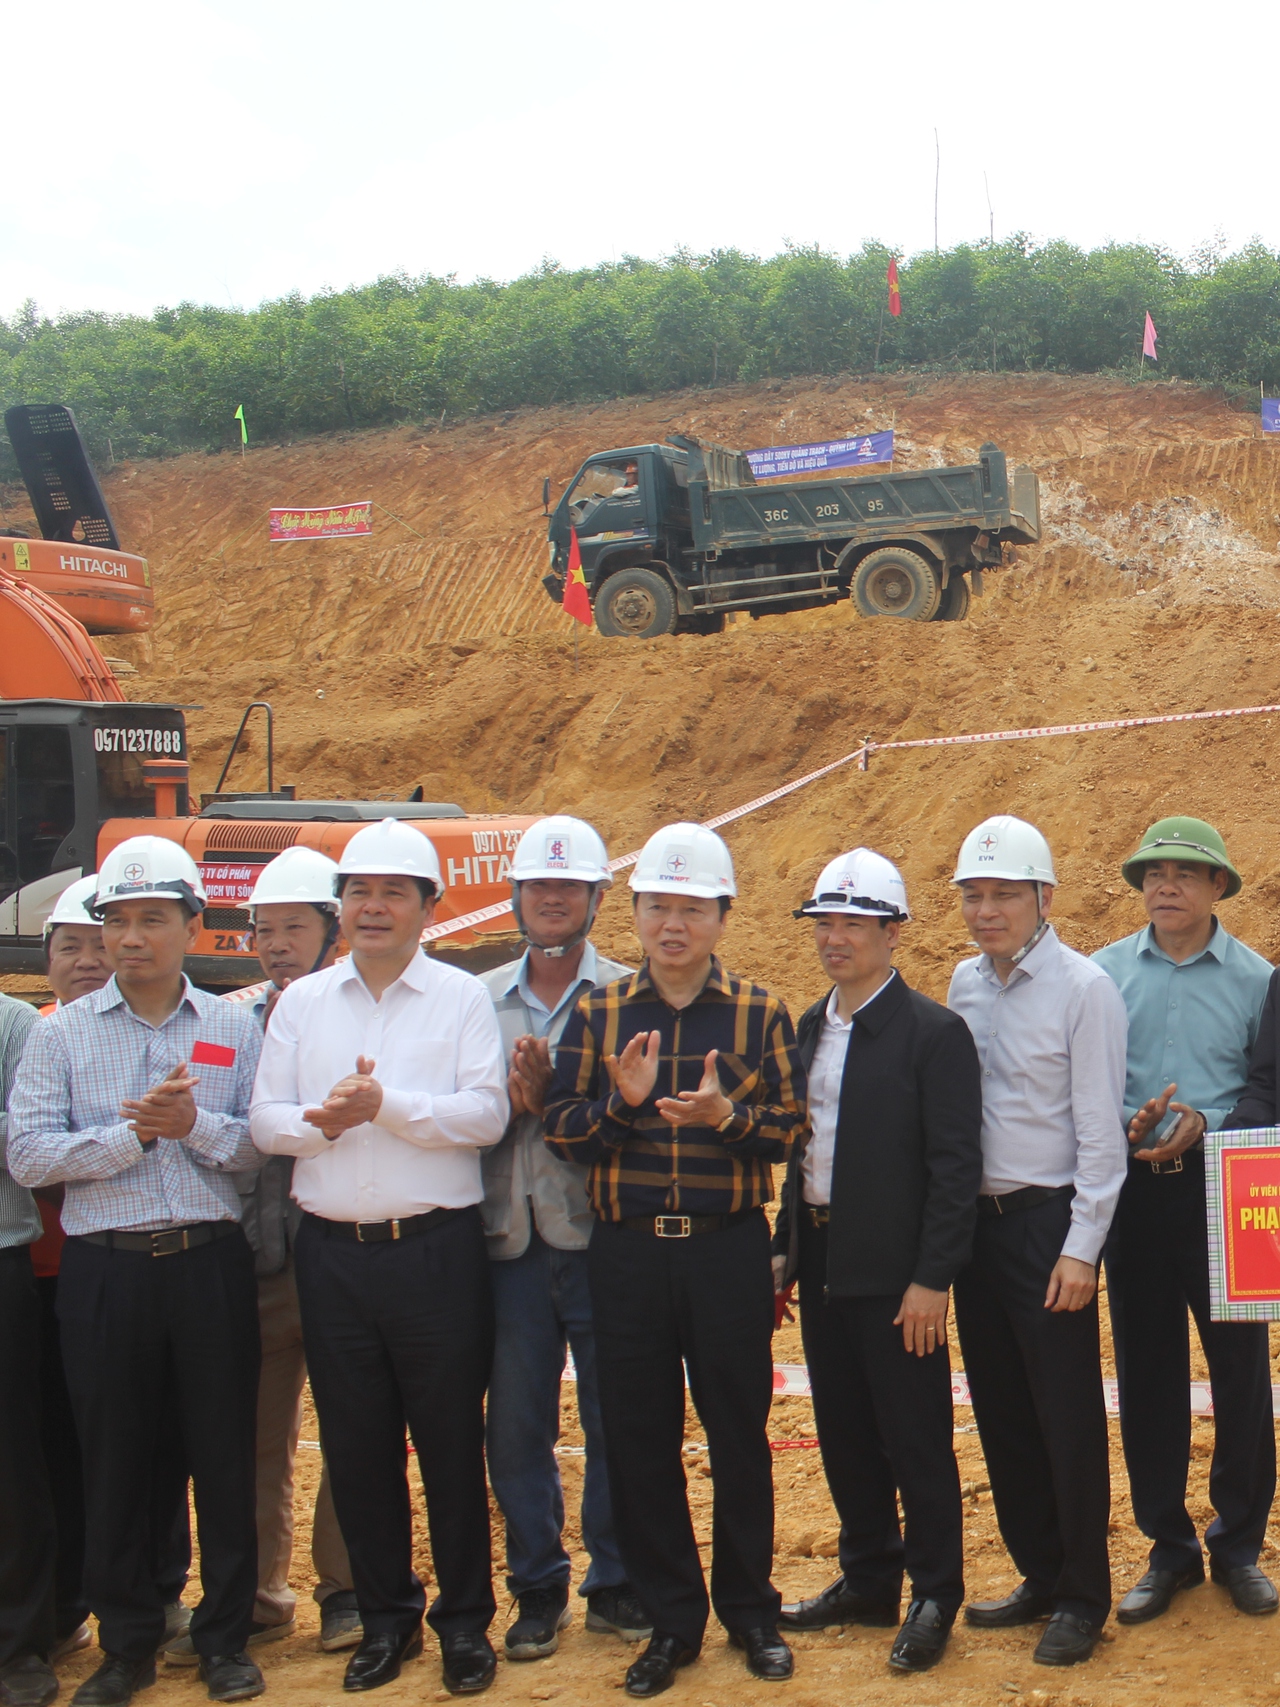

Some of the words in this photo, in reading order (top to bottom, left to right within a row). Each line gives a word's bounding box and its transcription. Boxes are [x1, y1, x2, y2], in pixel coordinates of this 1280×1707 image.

[764, 509, 789, 522] 36C
[816, 504, 839, 517] 203
[867, 500, 884, 512] 95
[60, 556, 128, 579] HITACHI
[94, 728, 181, 753] 0971237888
[472, 831, 502, 854] 0971
[206, 868, 216, 879] TY
[447, 854, 512, 886] HITA
[659, 874, 690, 883] EVNNPT
[206, 885, 224, 899] DỊCH
[226, 885, 236, 900] VỤ
[238, 884, 254, 898] SÔN
[215, 931, 254, 953] ZAXI
[1250, 1182, 1259, 1197] ỦY
[1261, 1184, 1278, 1197] VIÊN
